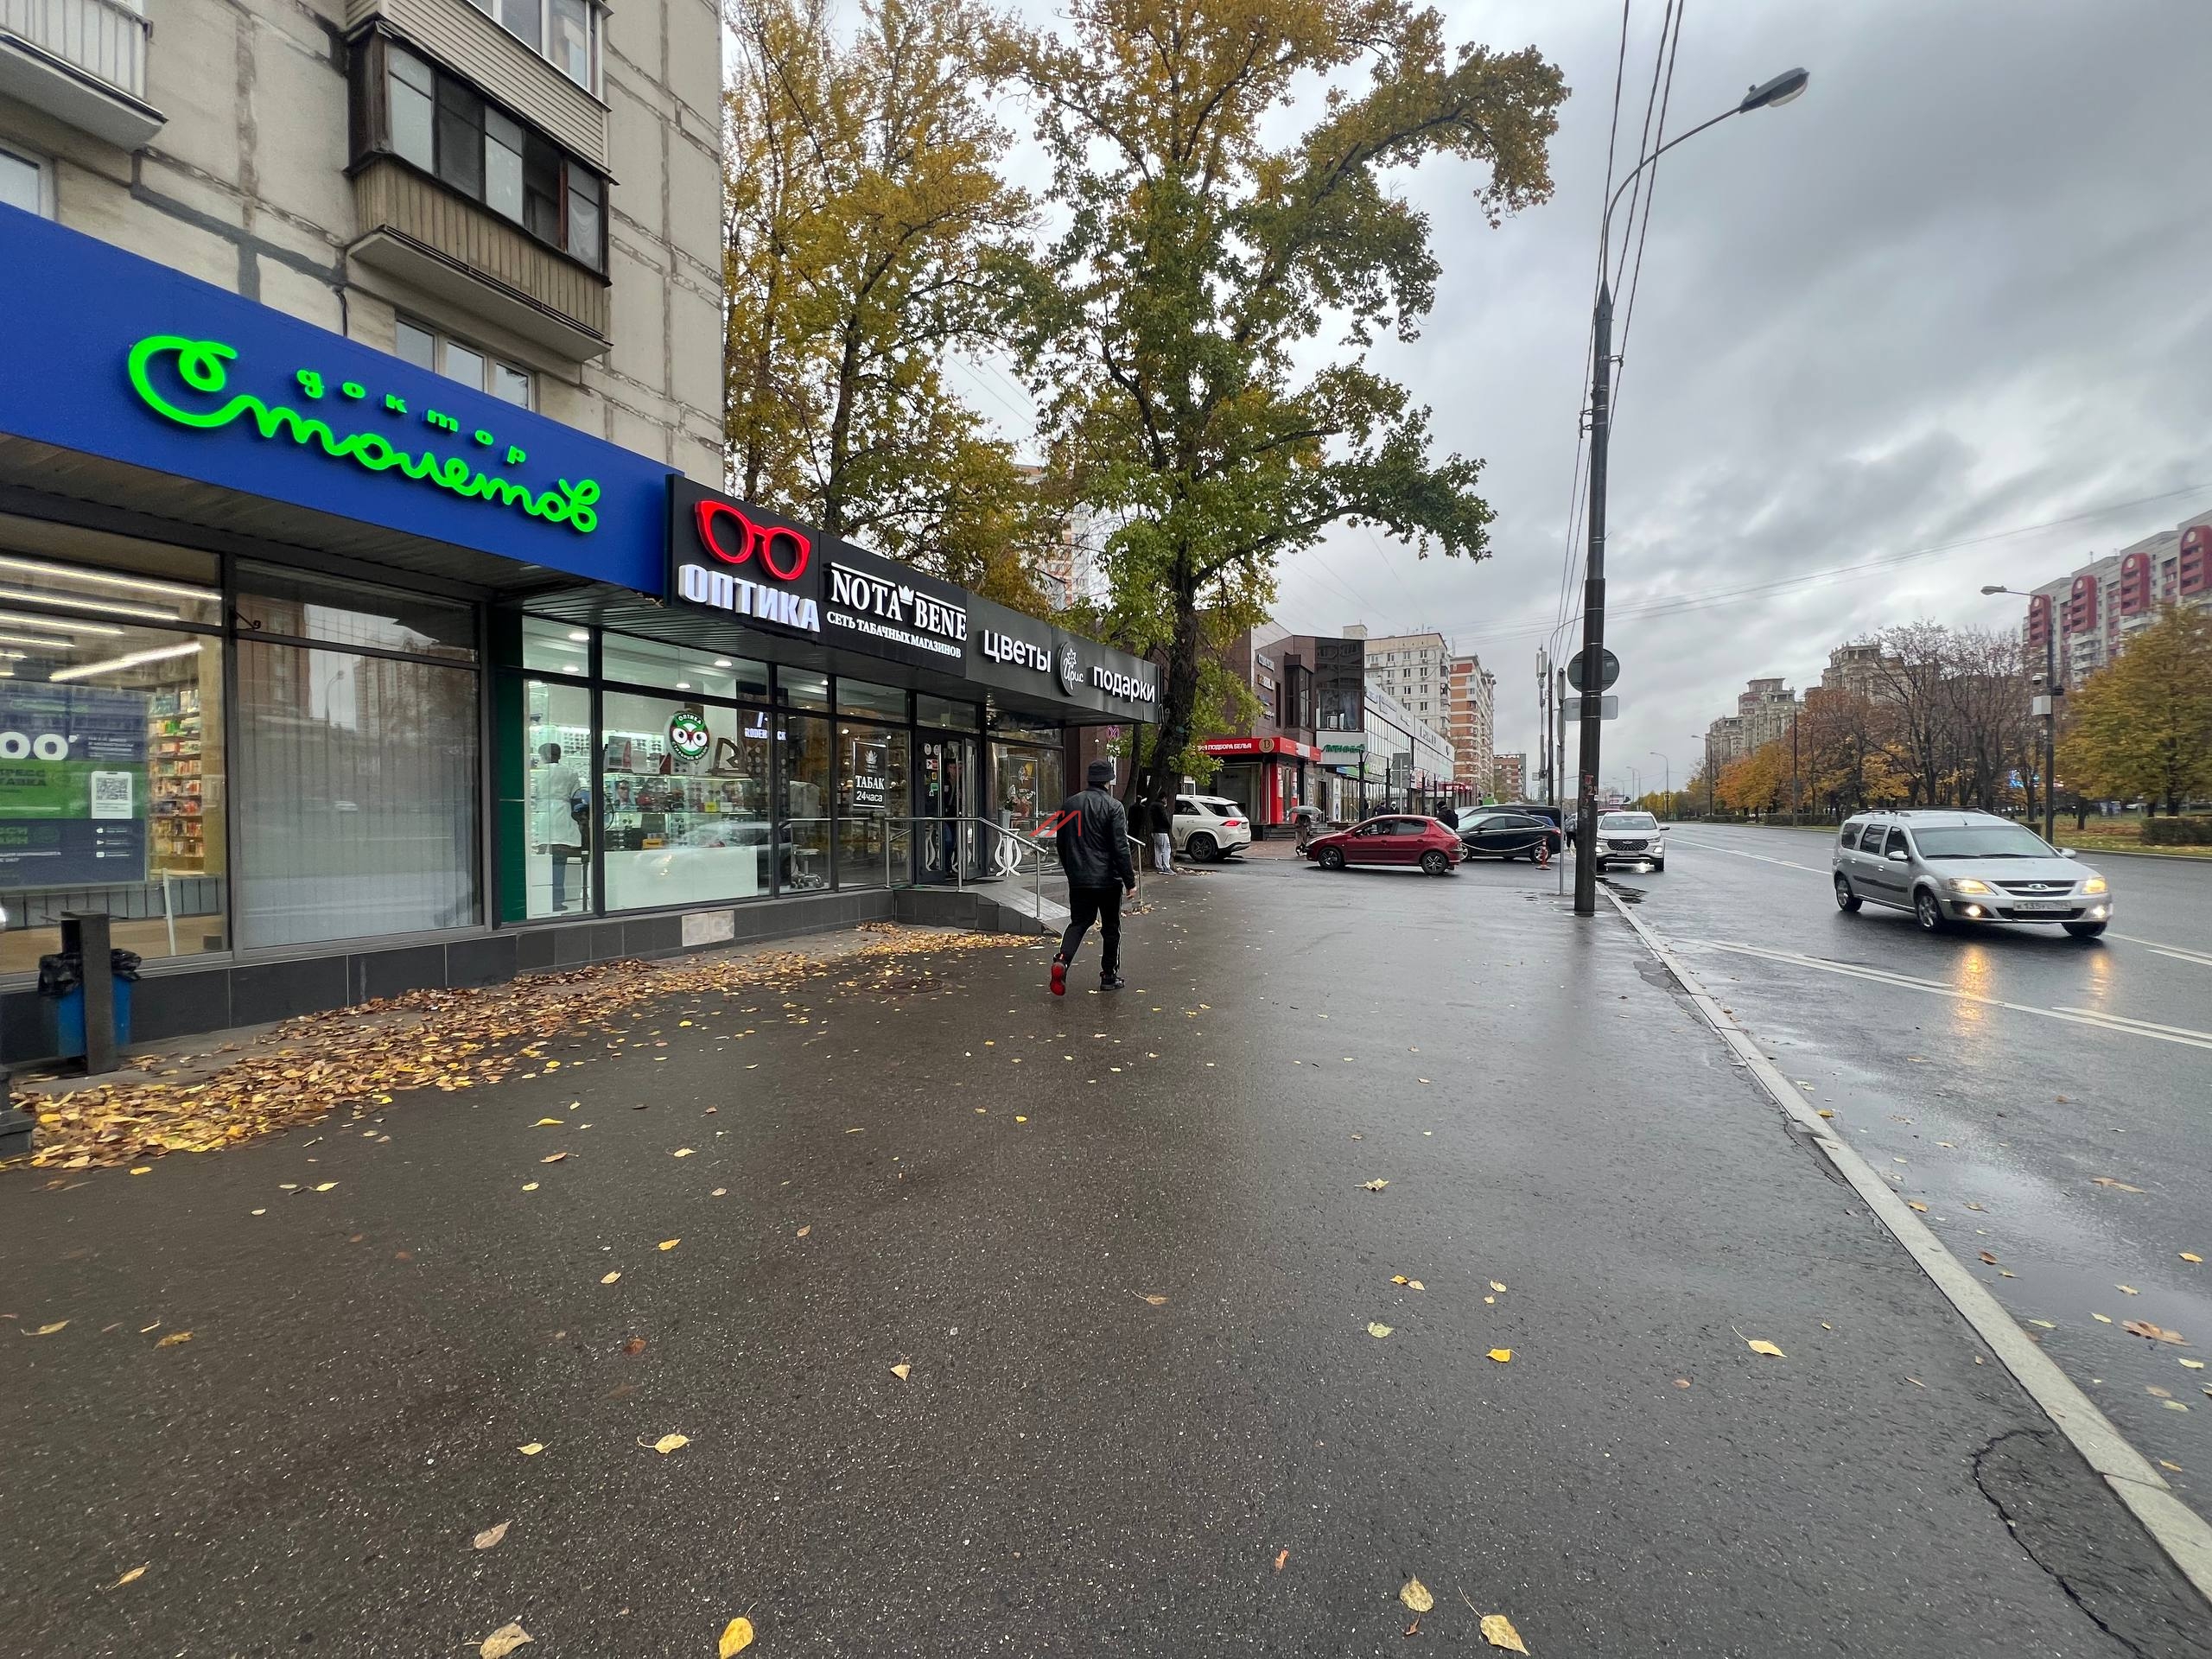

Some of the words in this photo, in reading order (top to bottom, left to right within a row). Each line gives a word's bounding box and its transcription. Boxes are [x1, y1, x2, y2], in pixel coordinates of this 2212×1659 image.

[128, 335, 601, 533] Столетов
[678, 564, 820, 632] ОПТИКА
[830, 569, 903, 621] NOTA
[913, 597, 968, 642] BENE
[826, 610, 857, 631] СЕТЬ
[856, 619, 911, 645] ТАБАЧНЫХ
[911, 634, 962, 658] МАГАЗИНОВ
[1063, 659, 1085, 690] Ирис
[1092, 665, 1156, 704] подарки
[855, 774, 885, 790] ТАБАК
